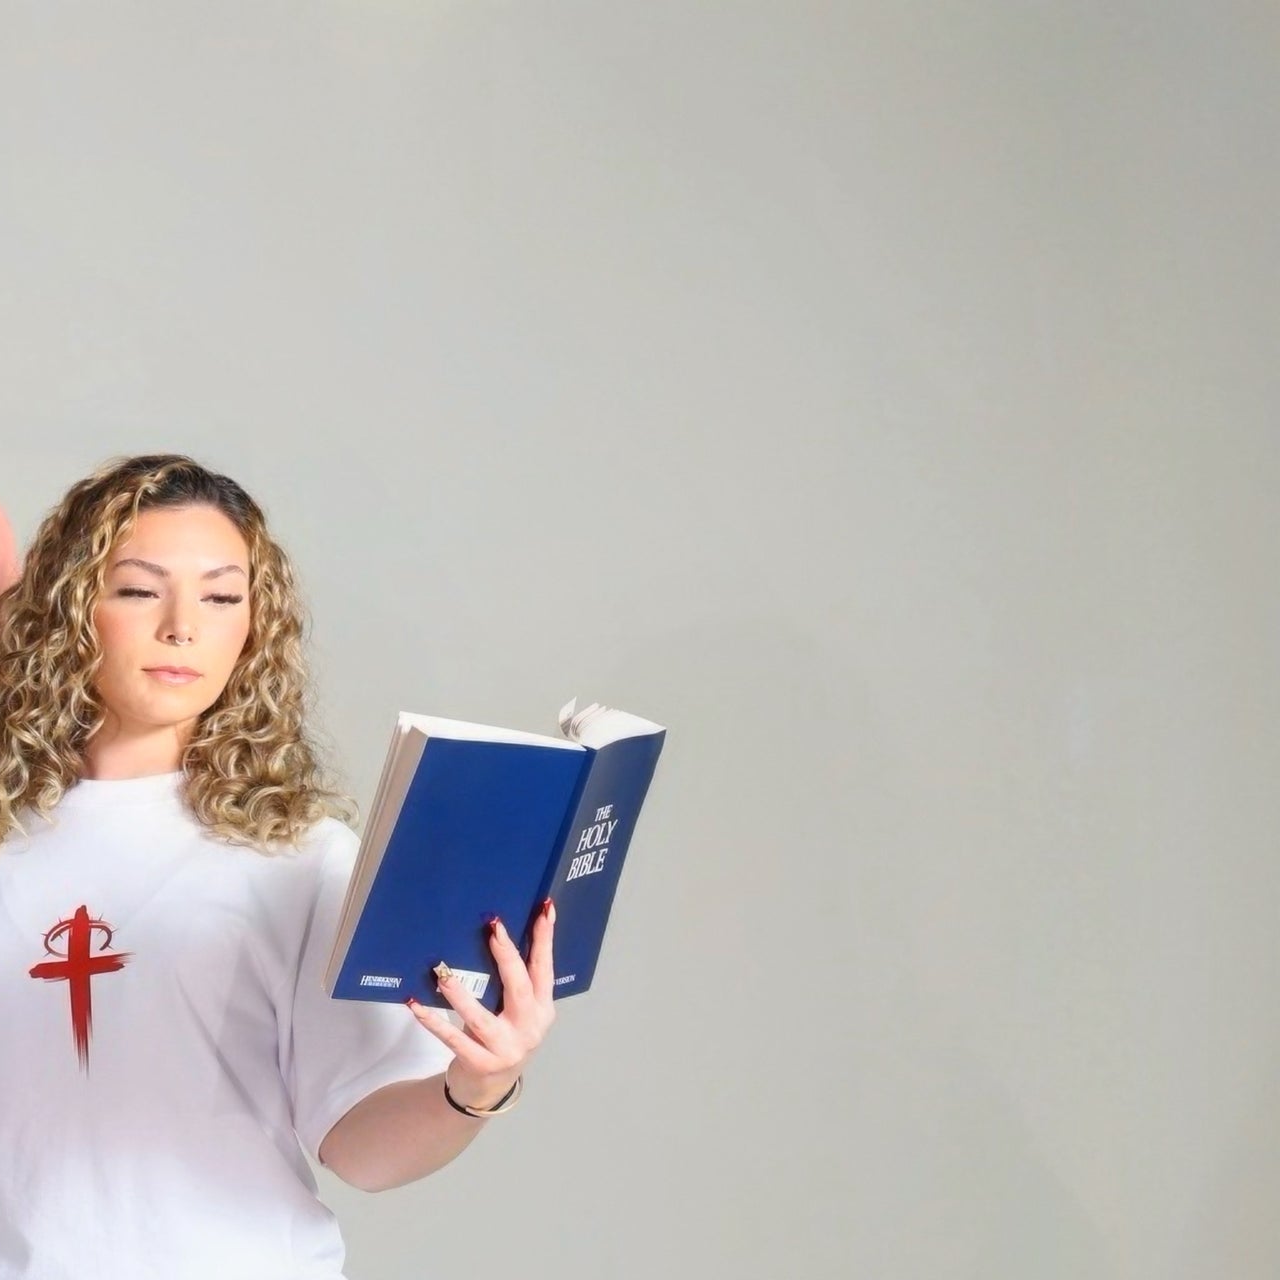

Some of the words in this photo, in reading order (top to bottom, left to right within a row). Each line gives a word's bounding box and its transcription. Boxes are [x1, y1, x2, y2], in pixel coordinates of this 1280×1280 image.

[594, 804, 614, 822] THE
[575, 819, 619, 853] HOLY
[566, 848, 609, 882] BIBLE
